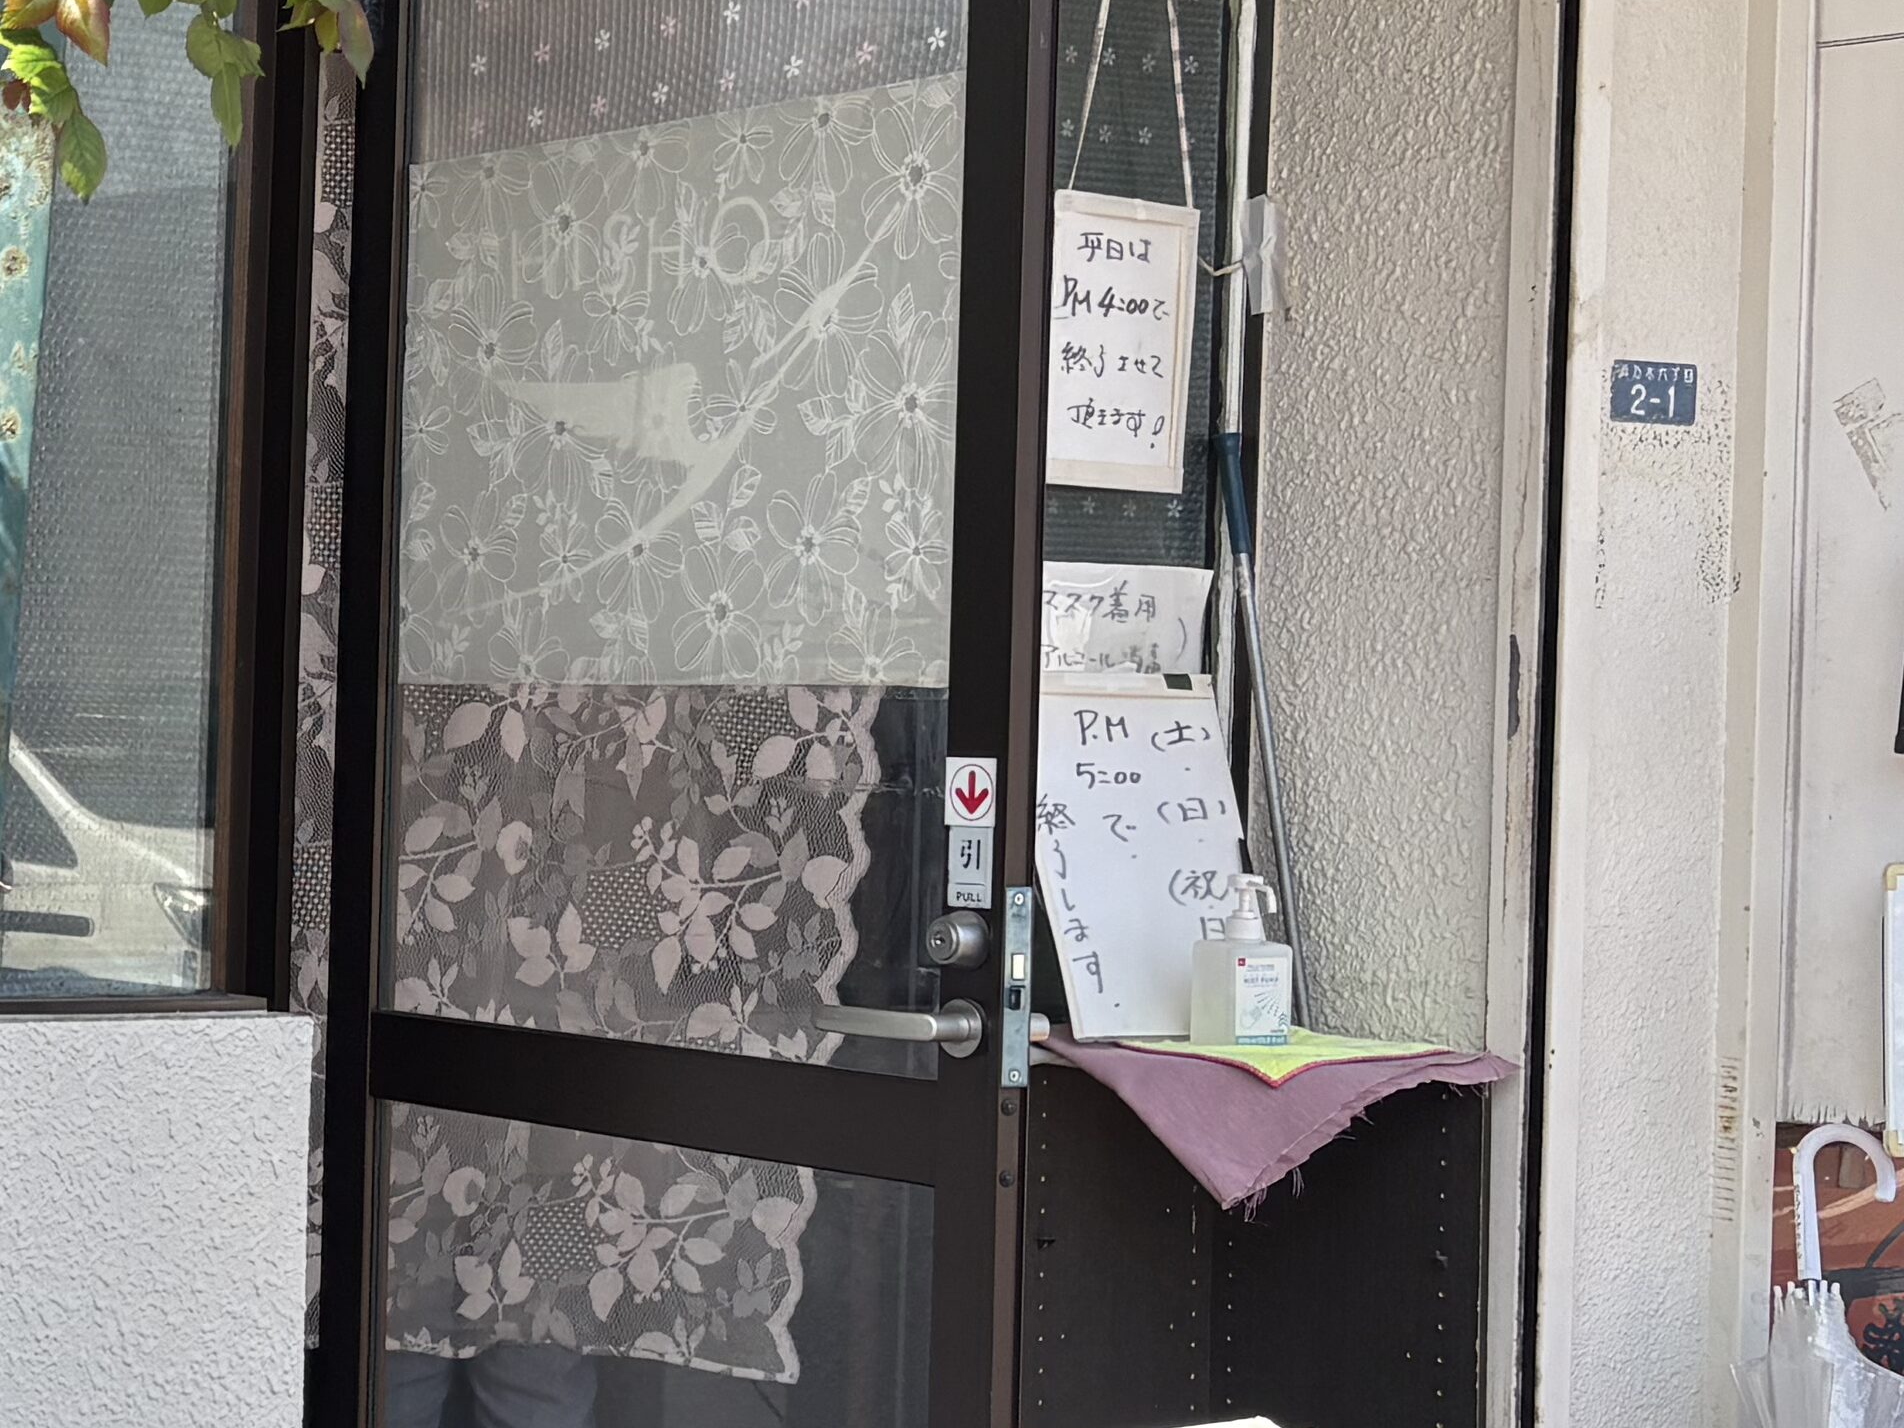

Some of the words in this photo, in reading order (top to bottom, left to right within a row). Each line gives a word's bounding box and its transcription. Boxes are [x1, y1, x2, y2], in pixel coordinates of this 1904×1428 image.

[1076, 231, 1152, 263] 平日は
[1630, 383, 1676, 418] 2-1
[960, 839, 981, 870] 引
[955, 890, 982, 903] PULL
